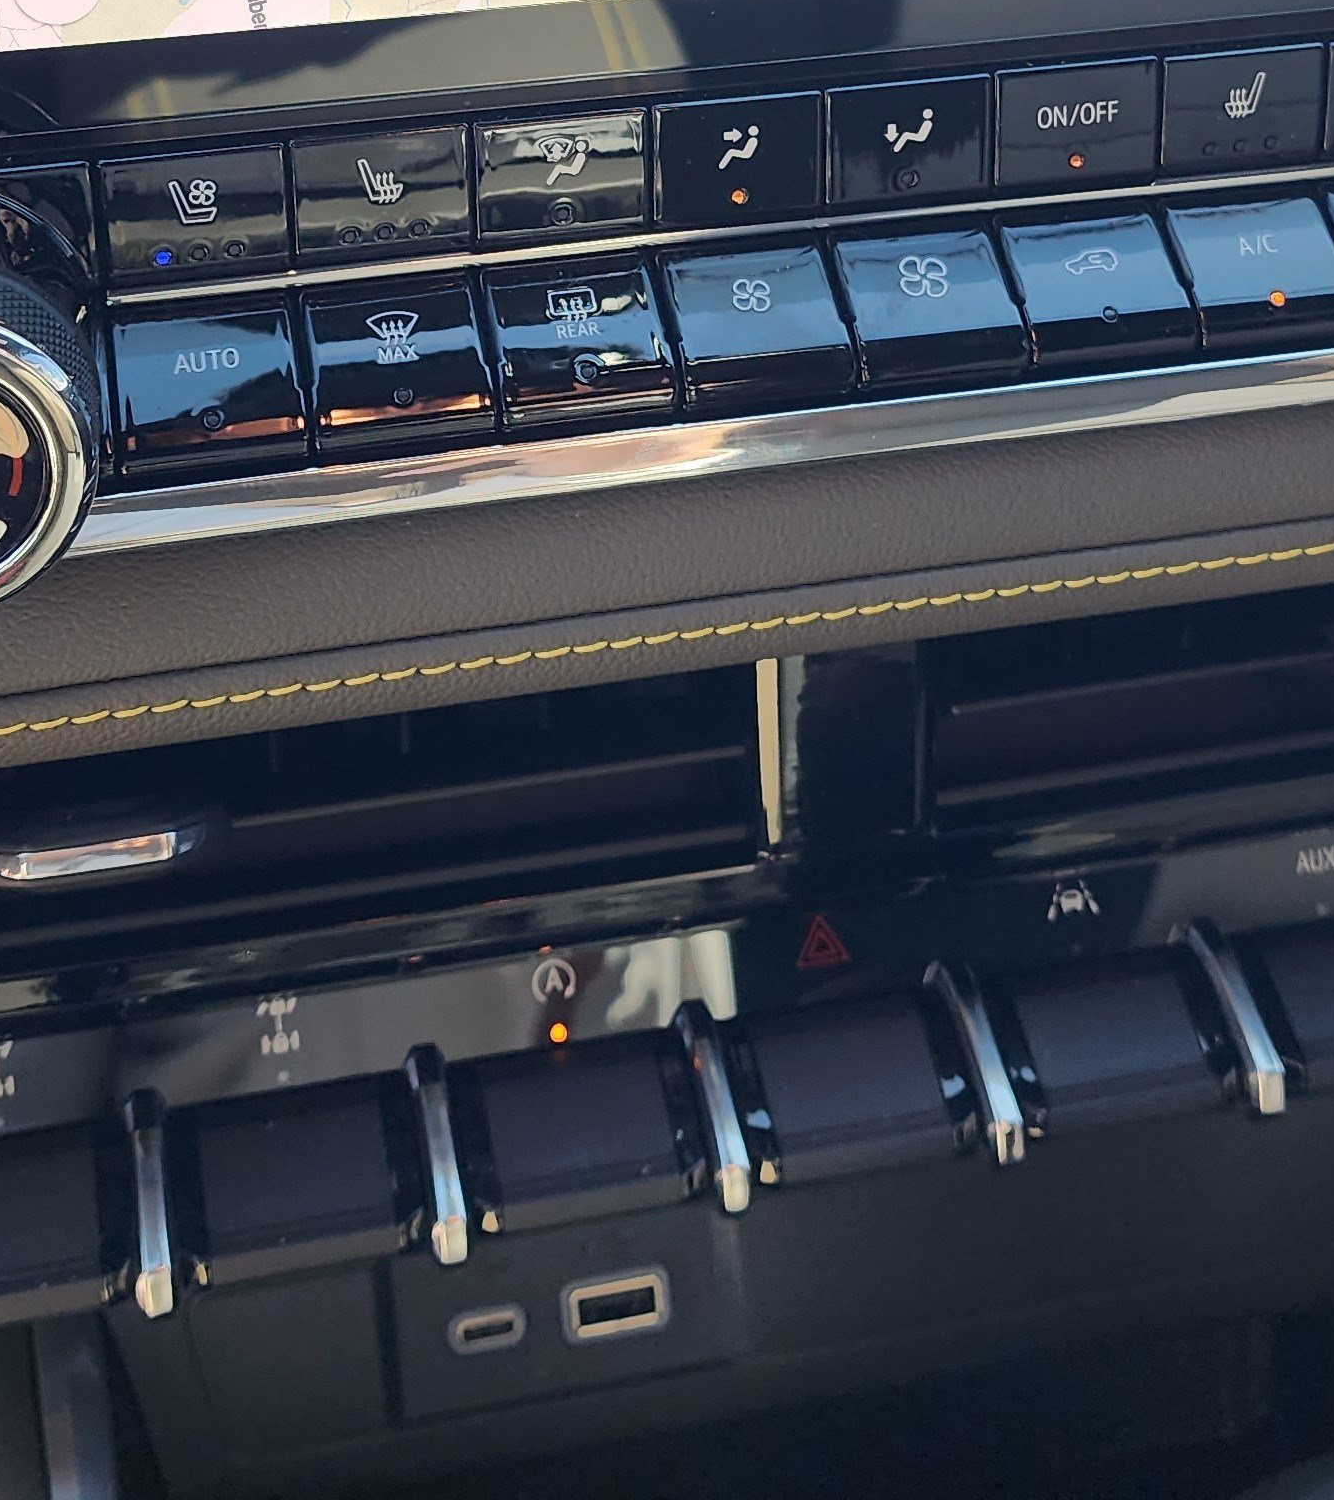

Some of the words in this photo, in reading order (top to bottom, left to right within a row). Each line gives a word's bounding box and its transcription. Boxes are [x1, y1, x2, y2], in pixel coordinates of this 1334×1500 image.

[1036, 99, 1120, 128] ON/OFF
[1239, 232, 1279, 256] A/C
[556, 320, 600, 340] REAR
[174, 347, 240, 375] AUTO
[376, 340, 421, 364] MAX
